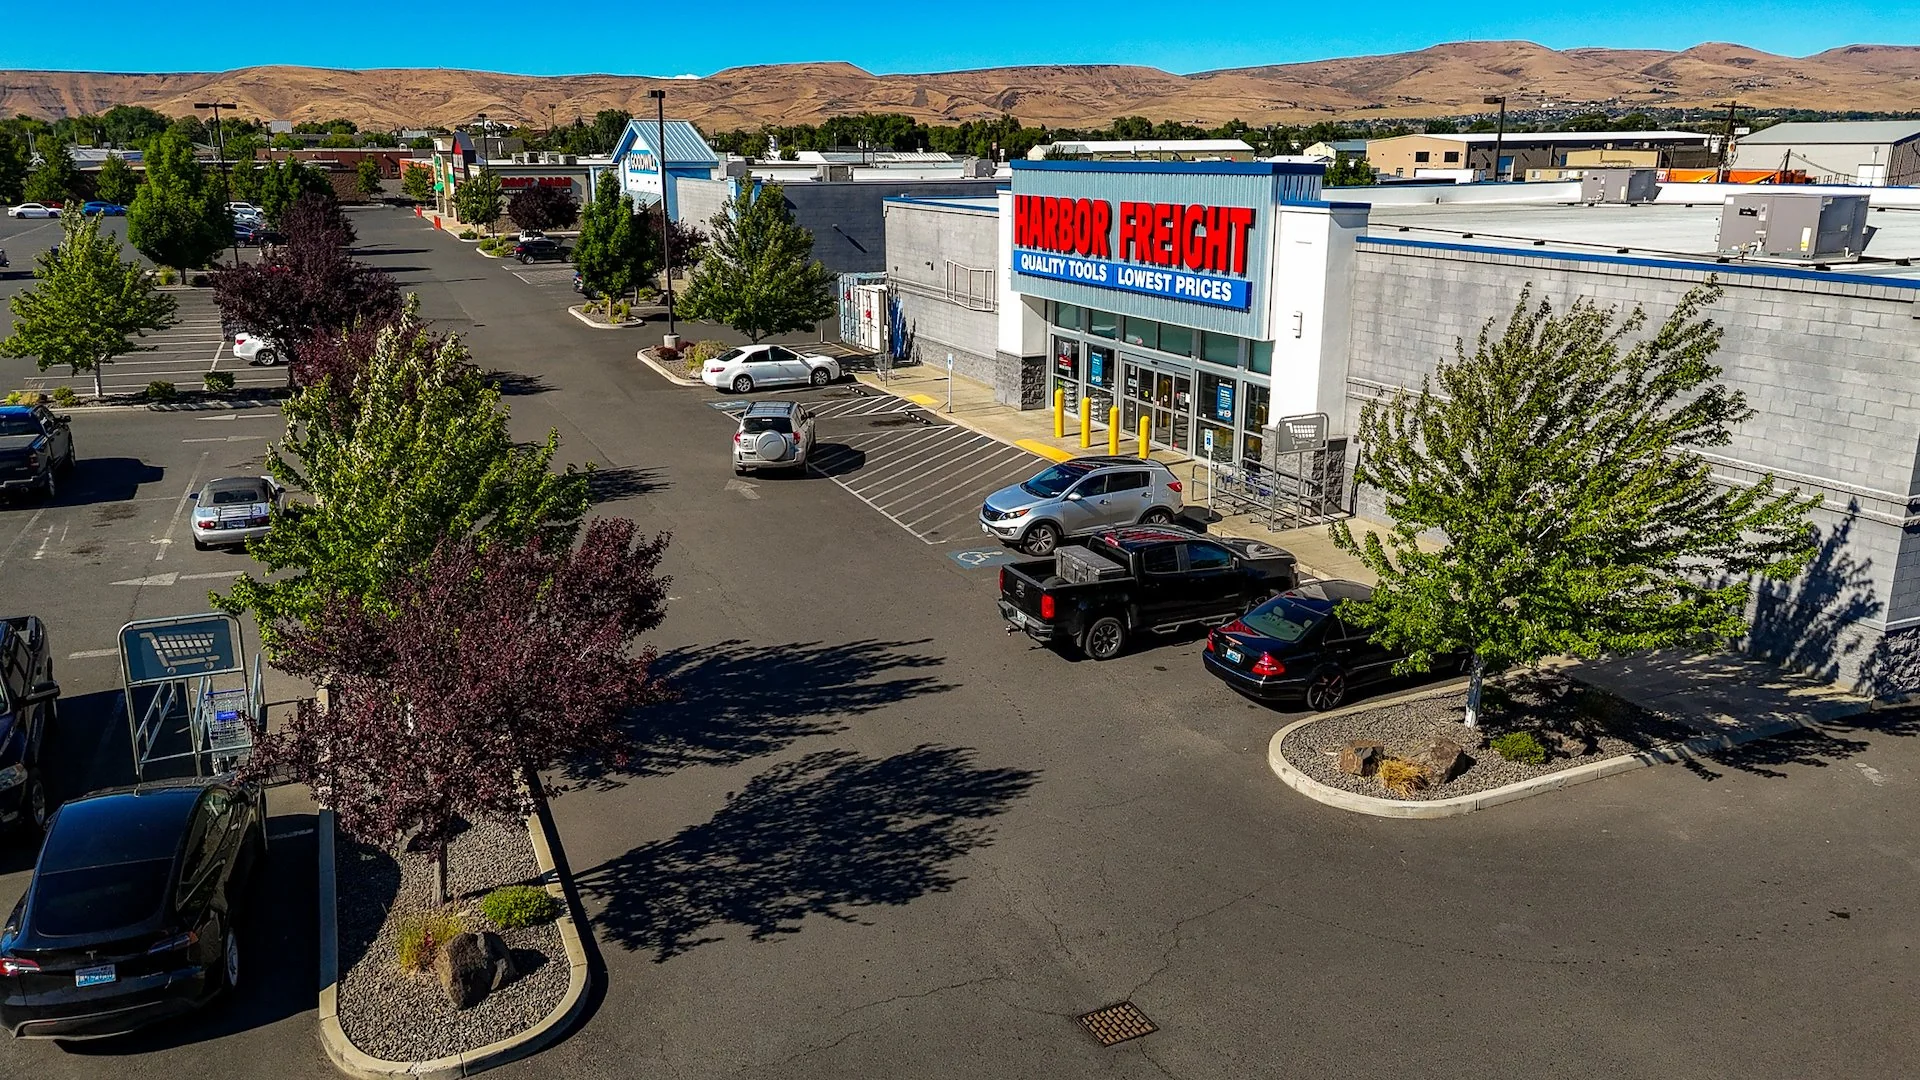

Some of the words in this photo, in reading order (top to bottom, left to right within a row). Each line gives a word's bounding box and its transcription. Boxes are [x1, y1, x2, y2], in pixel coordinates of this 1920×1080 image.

[1014, 194, 1110, 257] HARBOR
[1119, 201, 1253, 274] FREIGHT
[1021, 253, 1068, 275] QUALITY
[1068, 261, 1107, 281] TOOLS
[1118, 268, 1173, 293] LOWEST
[1175, 278, 1232, 302] PRICES
